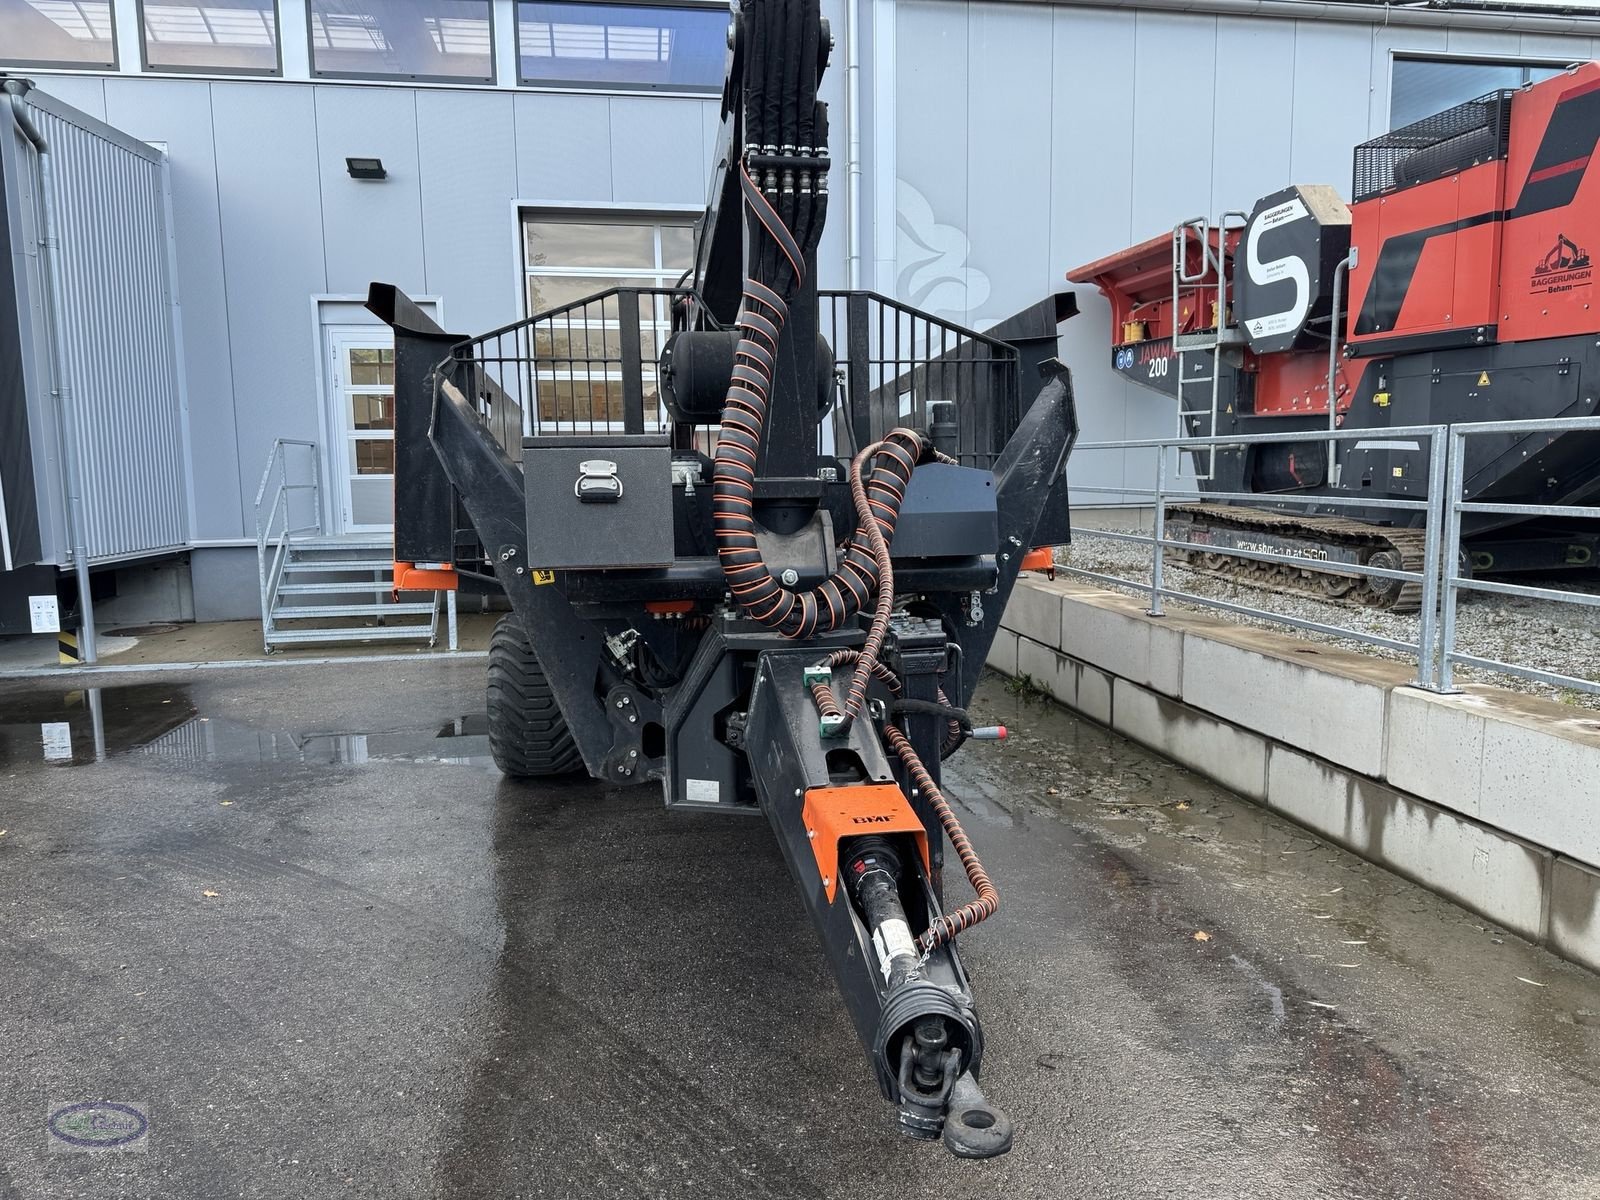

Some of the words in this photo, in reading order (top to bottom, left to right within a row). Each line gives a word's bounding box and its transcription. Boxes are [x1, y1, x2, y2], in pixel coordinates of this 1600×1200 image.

[1264, 206, 1293, 220] BAGGERUNGEN
[1531, 270, 1592, 287] BAGGERUNGEN
[1548, 285, 1572, 293] Beham
[1149, 356, 1168, 378] 200
[852, 814, 895, 824] BMF
